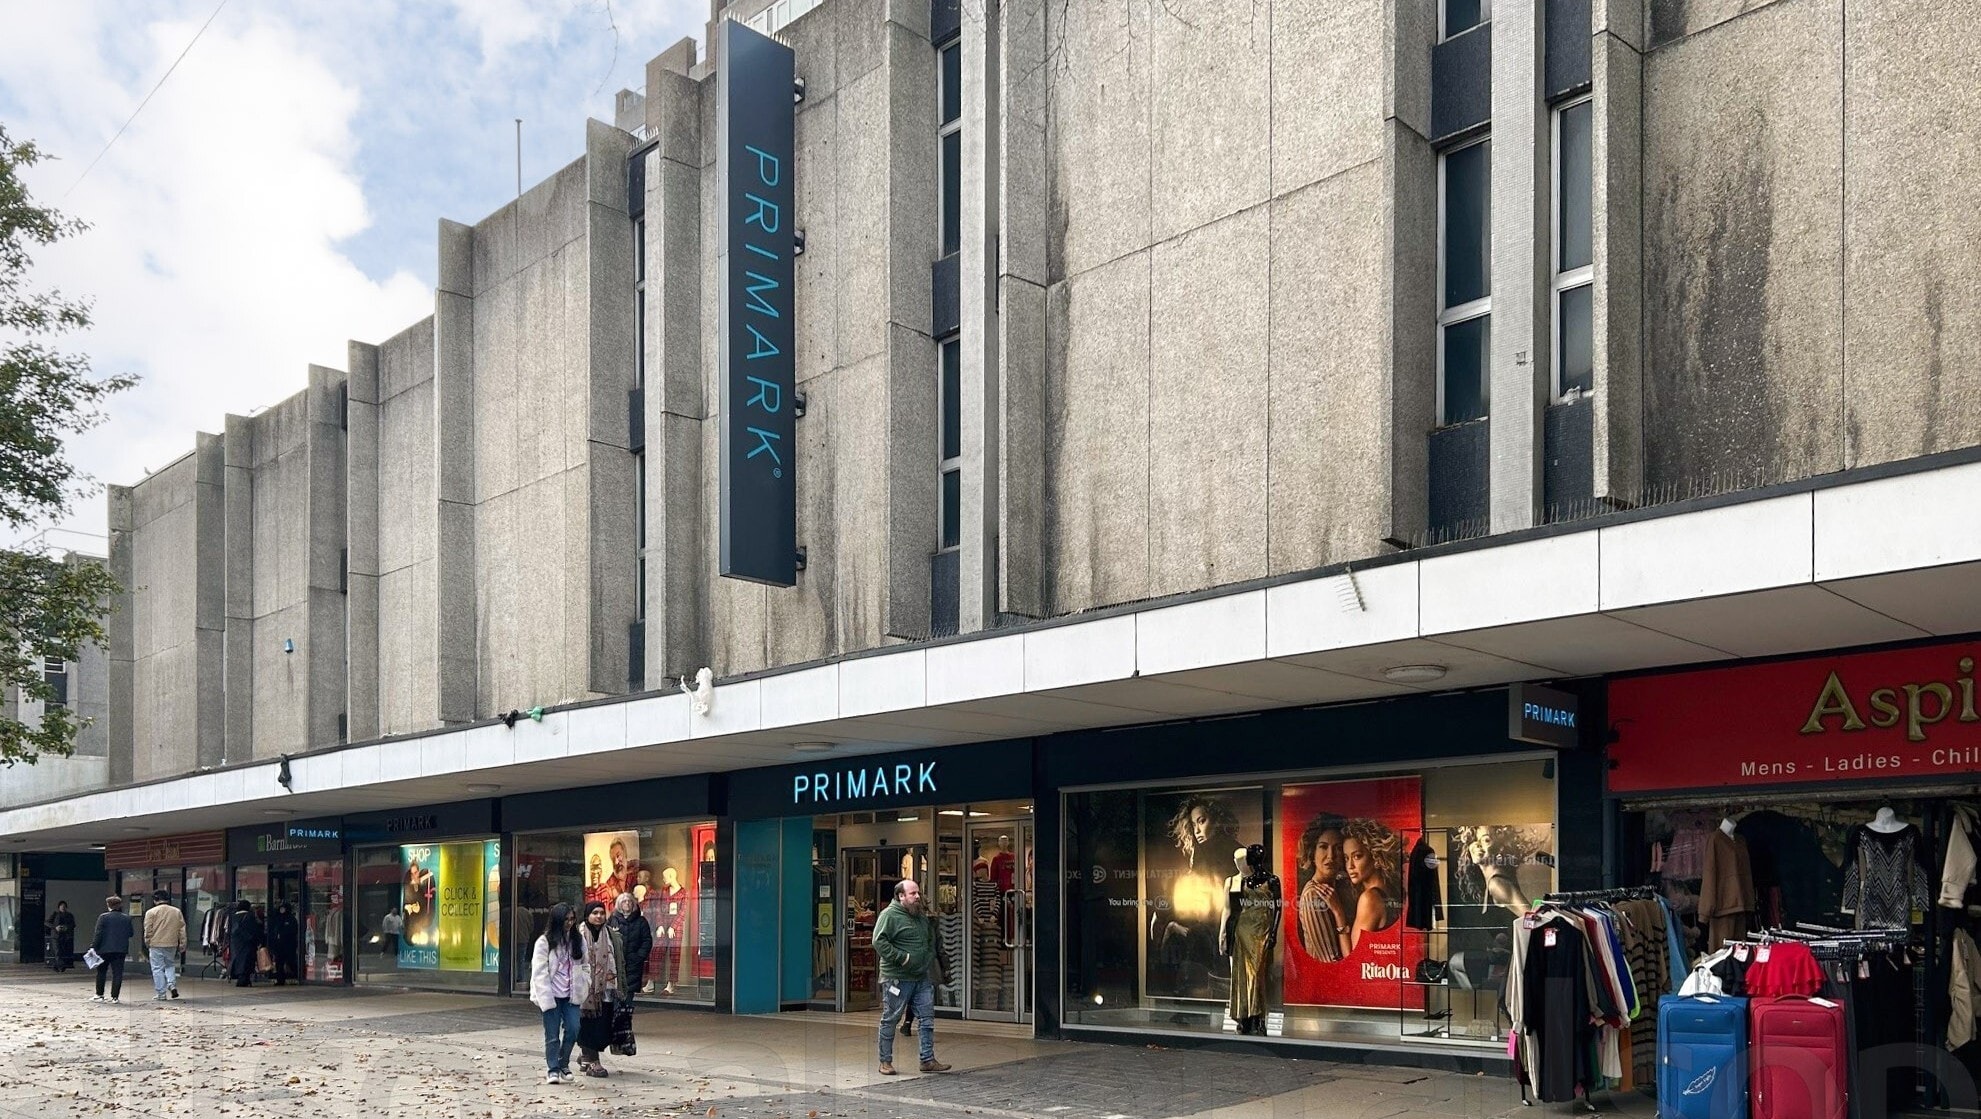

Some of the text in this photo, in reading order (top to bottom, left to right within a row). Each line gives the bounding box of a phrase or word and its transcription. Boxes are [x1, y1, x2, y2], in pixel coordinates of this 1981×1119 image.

[1800, 657, 1981, 741] Aspi
[1523, 702, 1576, 728] PRIMARK
[1741, 760, 1796, 776] Mens
[1824, 753, 1901, 771] Ladies
[1932, 747, 1979, 765] Chil
[793, 761, 937, 803] PRIMARK
[386, 815, 431, 832] PRIMARK
[289, 828, 339, 839] PRIMARK
[407, 848, 431, 862] SHOP
[444, 887, 477, 901] CLICK &
[441, 903, 480, 916] COLLECT
[1108, 898, 1121, 906] You
[1158, 898, 1169, 909] joy
[1239, 898, 1251, 906] We
[1253, 897, 1275, 909] bring
[399, 950, 417, 964] LIKE
[418, 950, 437, 965] THIS
[485, 952, 500, 966] LIK
